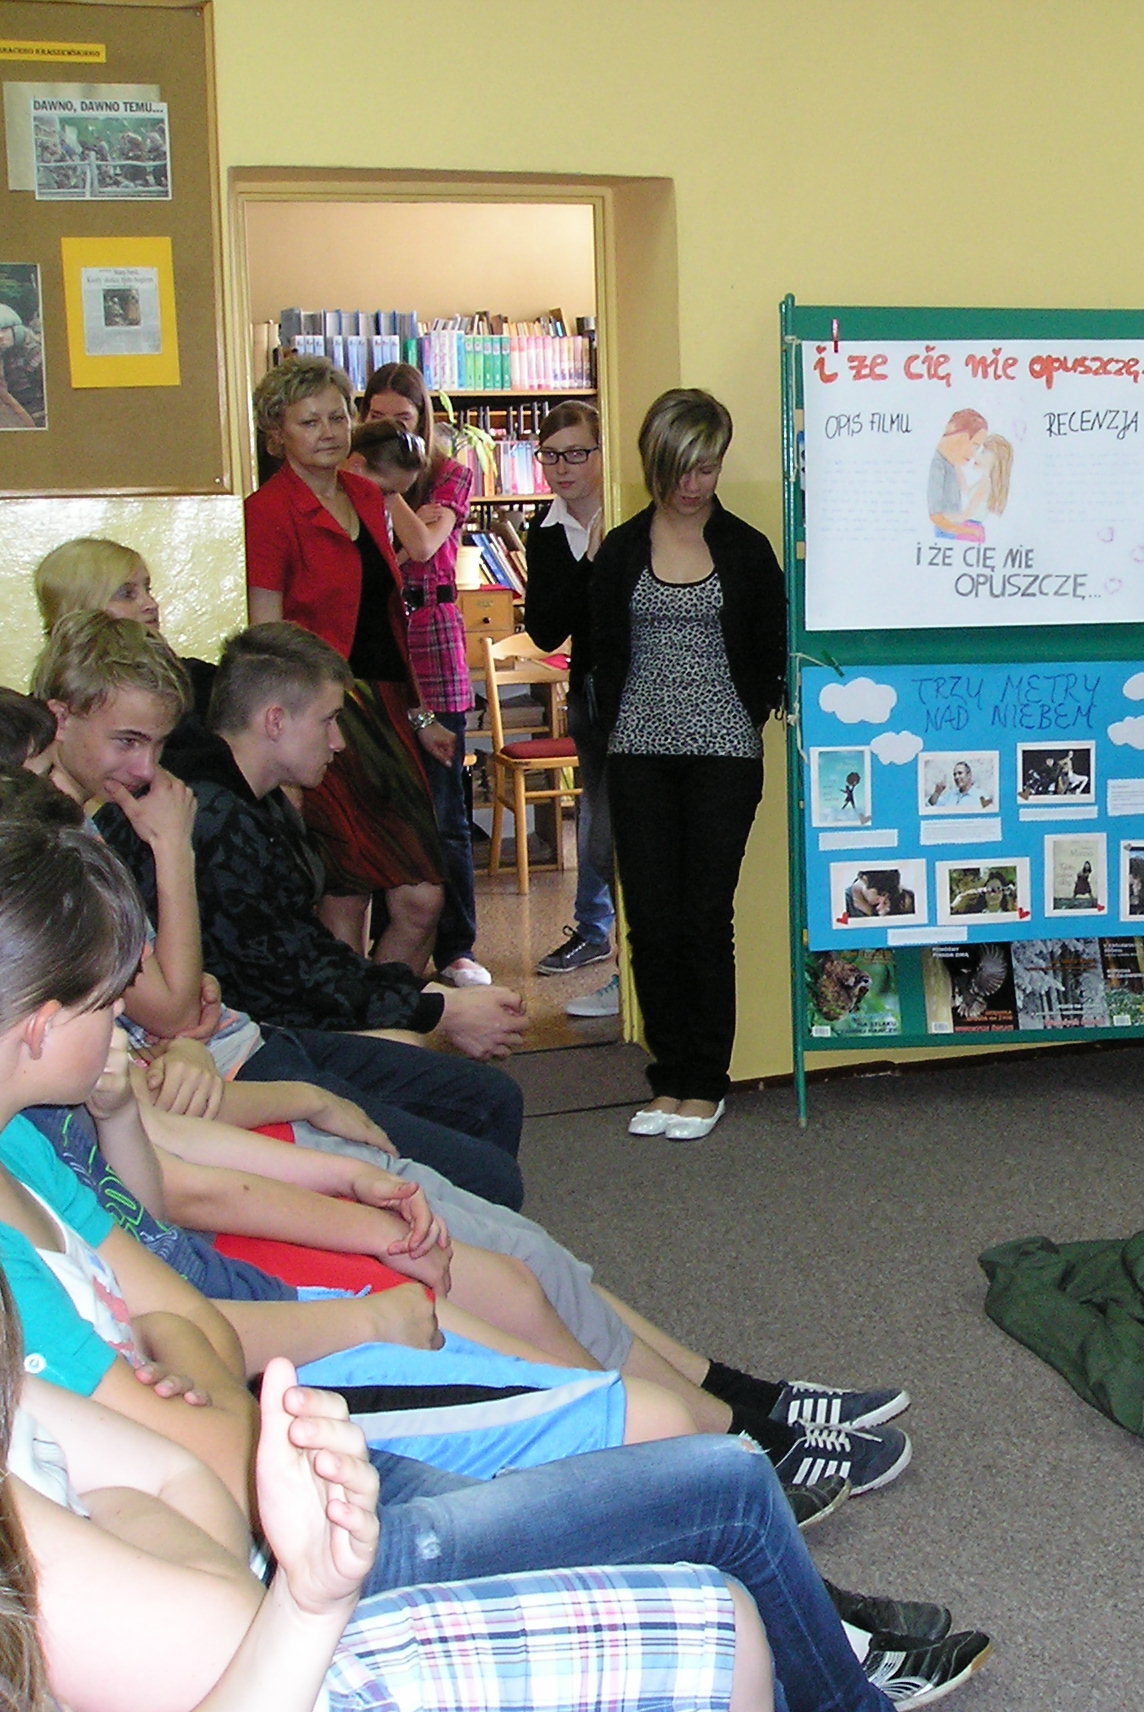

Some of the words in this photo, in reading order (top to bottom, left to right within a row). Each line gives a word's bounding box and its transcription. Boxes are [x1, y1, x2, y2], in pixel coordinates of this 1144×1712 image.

[33, 99, 77, 113] DAWNO,
[80, 101, 120, 113] DAWNO
[123, 102, 164, 113] TEMU...
[965, 345, 1017, 381] nie
[824, 413, 864, 440] OPIS
[870, 412, 912, 434] FILMU
[1044, 410, 1140, 440] RECENZJA
[911, 678, 983, 707] TRZY
[1000, 674, 1101, 702] METRY
[924, 708, 970, 732] NAD
[992, 704, 1098, 731] NIEBEM
